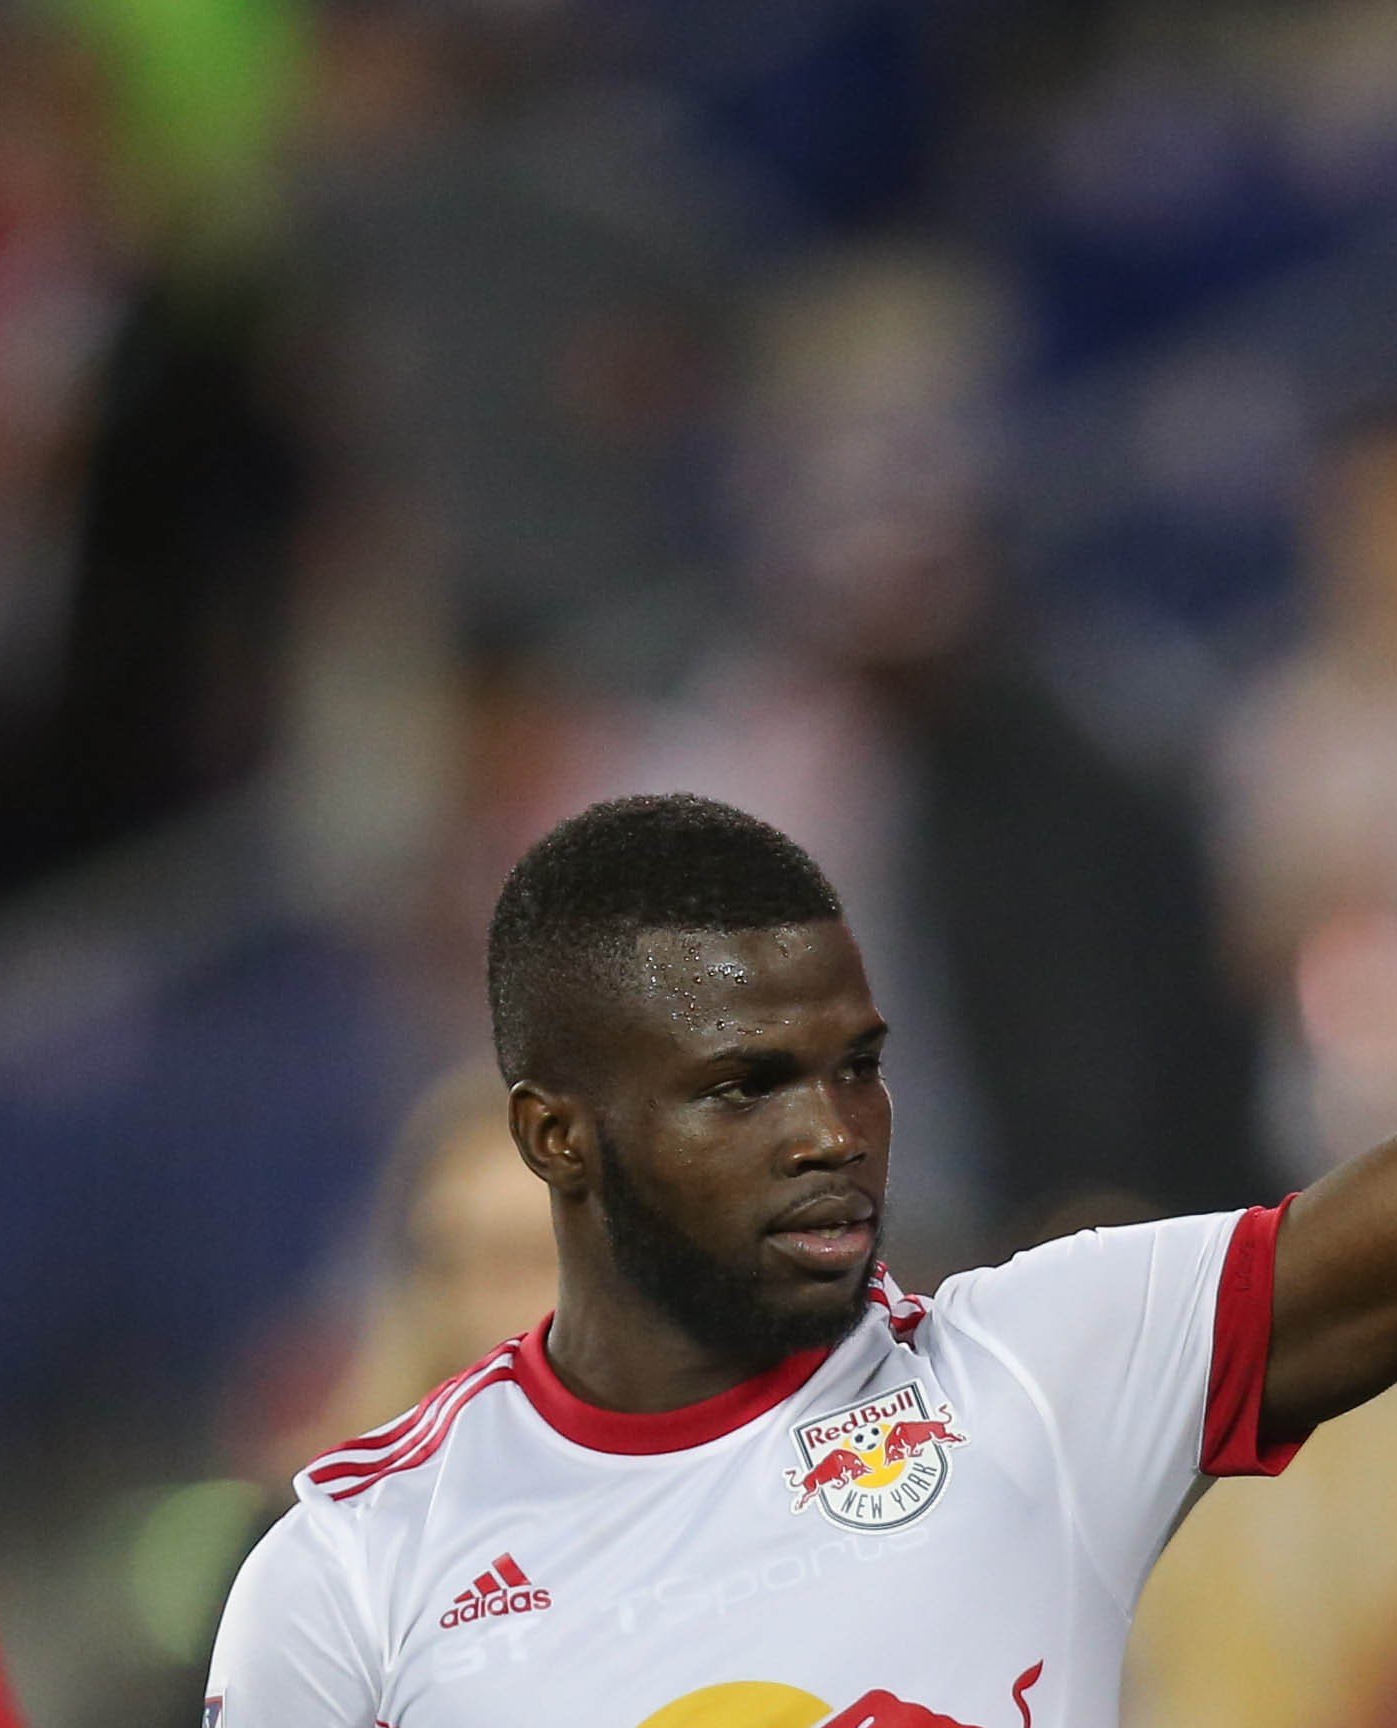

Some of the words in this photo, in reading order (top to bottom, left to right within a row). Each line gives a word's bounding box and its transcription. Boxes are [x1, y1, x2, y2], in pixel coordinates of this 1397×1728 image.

[805, 1412, 859, 1449] Red
[860, 1390, 915, 1425] Bull
[840, 1489, 883, 1519] NEW
[890, 1461, 938, 1511] YORK
[439, 1587, 552, 1629] adidas
